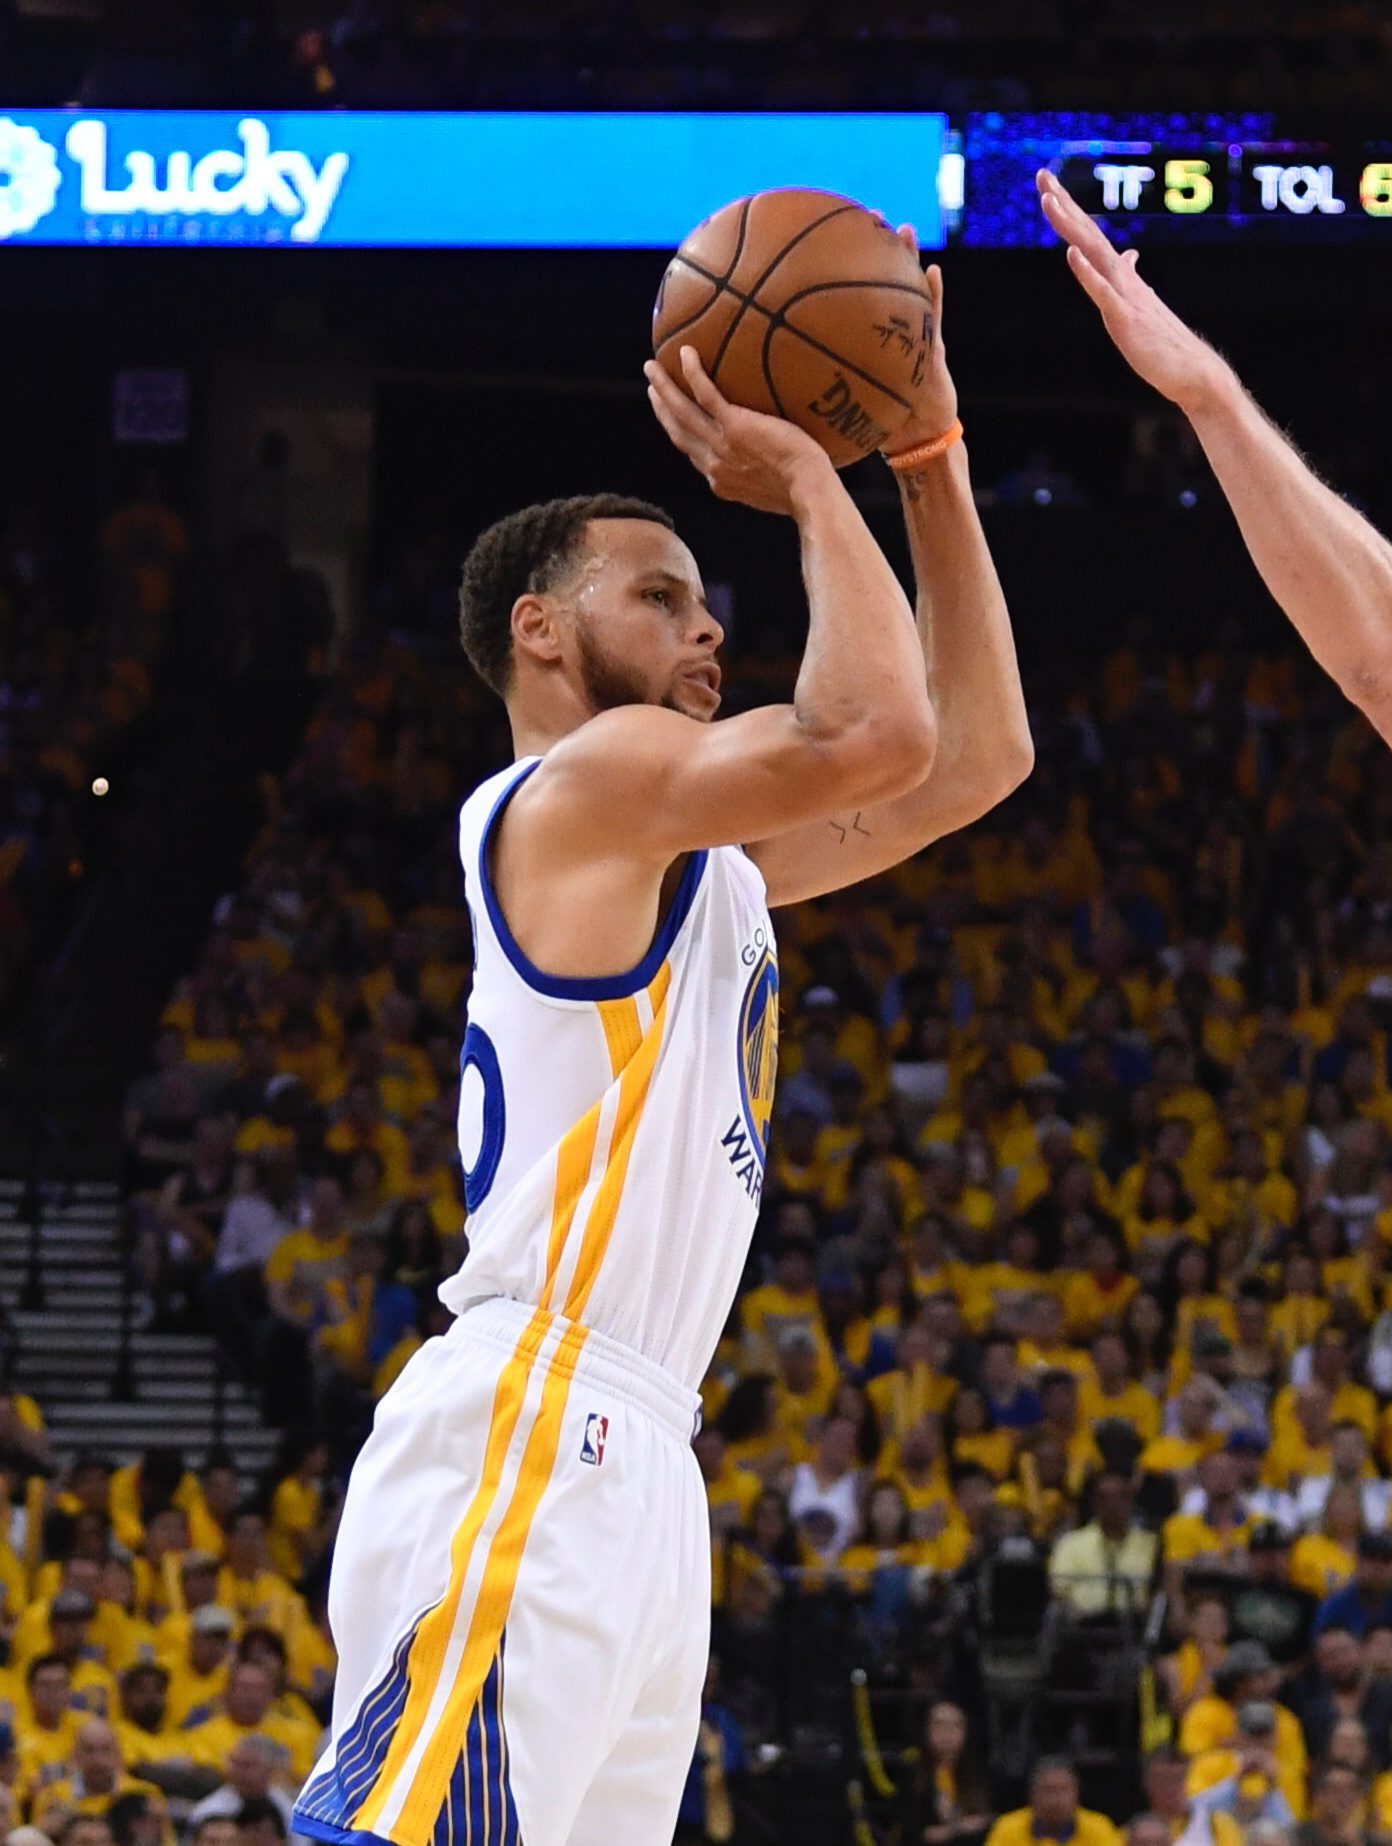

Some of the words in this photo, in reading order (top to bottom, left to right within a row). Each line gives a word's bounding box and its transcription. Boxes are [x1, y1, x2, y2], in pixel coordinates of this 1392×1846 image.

[66, 118, 349, 242] Lucky
[1094, 165, 1155, 211] TF
[1164, 159, 1213, 214] 5
